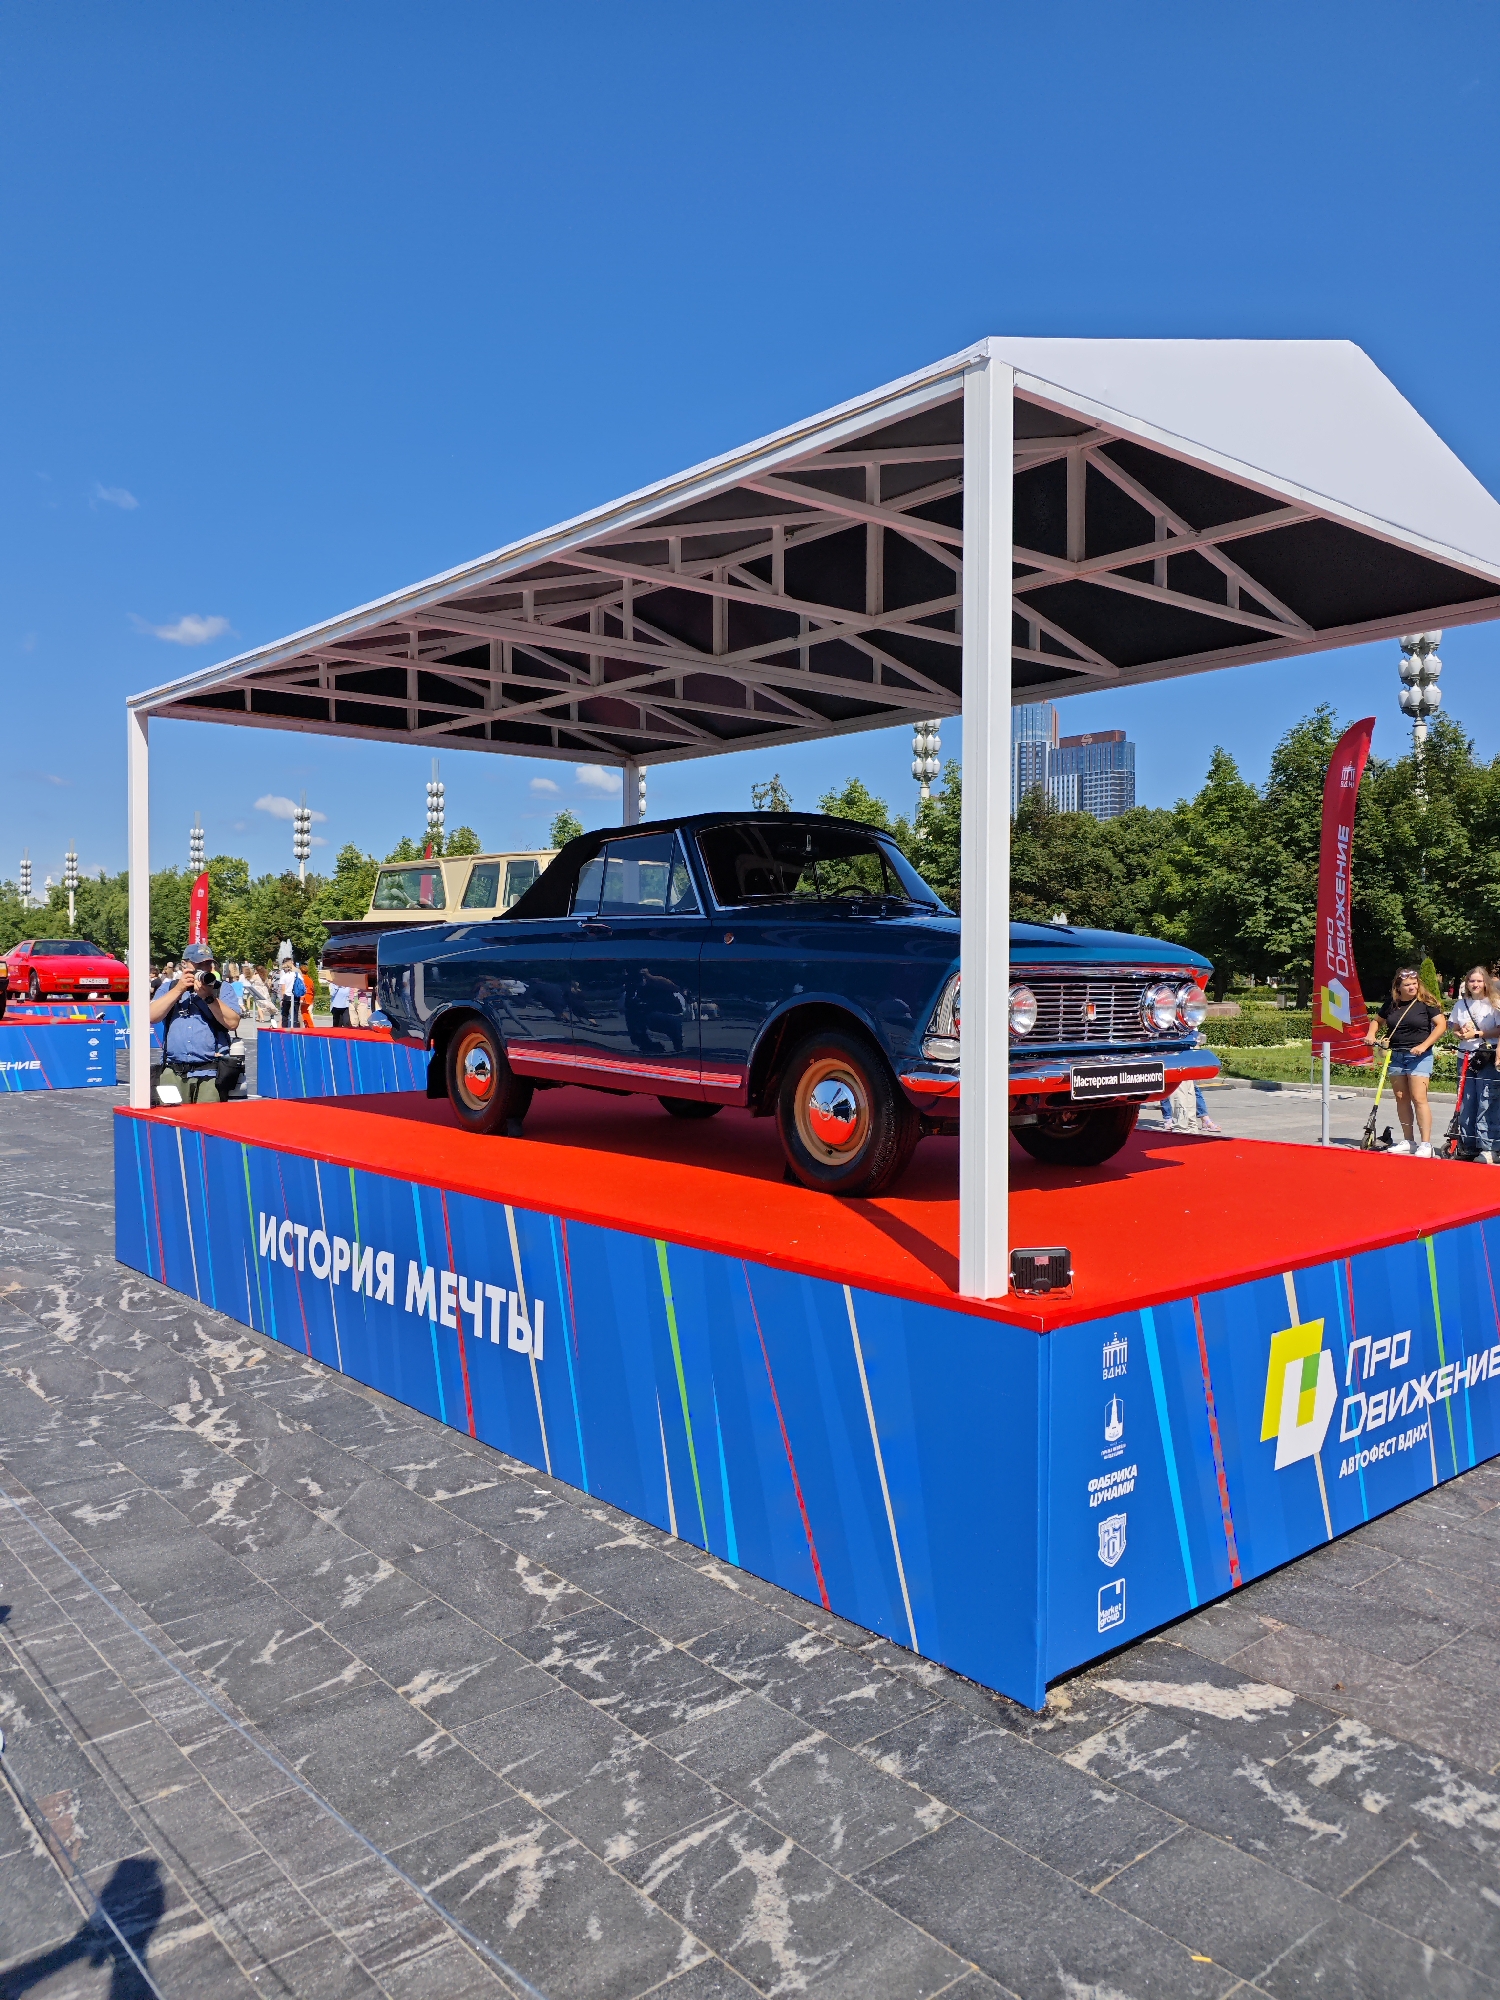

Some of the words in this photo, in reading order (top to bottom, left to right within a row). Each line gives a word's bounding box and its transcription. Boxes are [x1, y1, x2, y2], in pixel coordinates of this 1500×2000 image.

[1073, 1076, 1118, 1088] Мастерская
[1119, 1072, 1163, 1084] Шаманского
[259, 1211, 395, 1306] ИСТОРИЯ
[404, 1260, 545, 1361] МЕЧТЫ
[1102, 1363, 1128, 1381] ВДНХ
[1339, 1436, 1397, 1479] АВТОФЕСТ
[1397, 1422, 1429, 1451] ВДНХ
[1087, 1464, 1138, 1492] ФАБРИКА
[1089, 1479, 1135, 1508] ЦУНАМИ
[1099, 1602, 1122, 1619] Market
[1099, 1611, 1120, 1628] group
